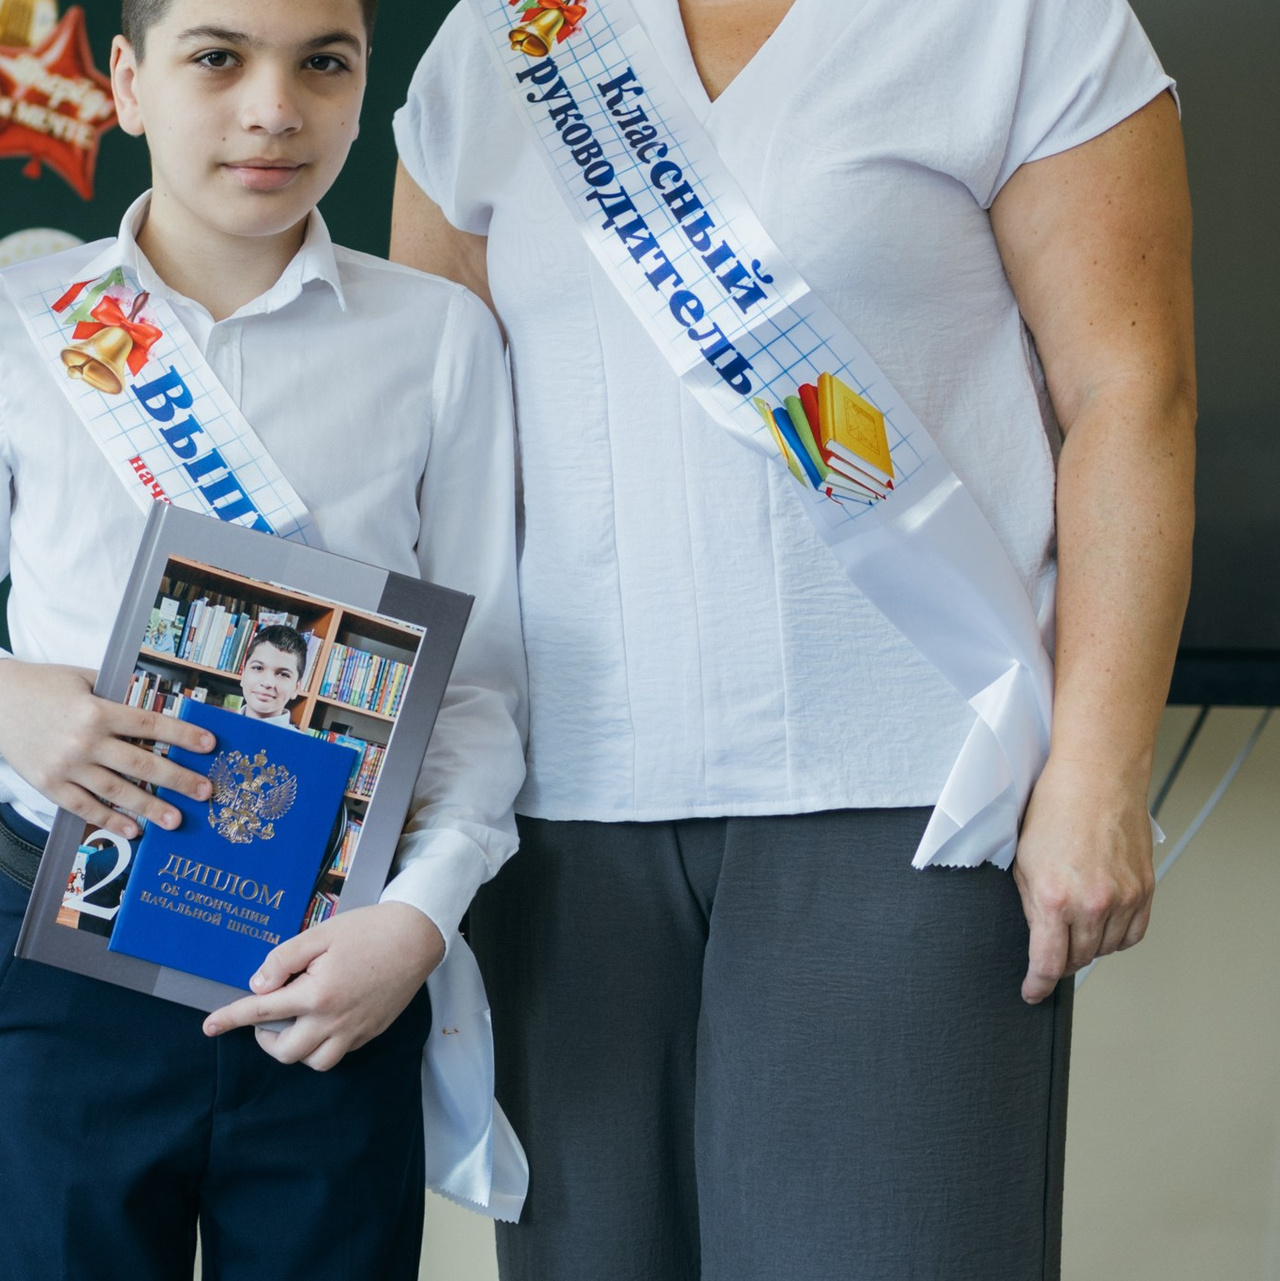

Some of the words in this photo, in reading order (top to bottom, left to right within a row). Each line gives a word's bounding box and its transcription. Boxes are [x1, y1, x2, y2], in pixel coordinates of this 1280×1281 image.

[596, 67, 774, 315] Классный
[515, 57, 754, 396] руководитель
[158, 853, 286, 910] ДИПЛОМ
[160, 882, 180, 896] ОБ
[184, 889, 270, 926] ОКОНЧАНИИ
[139, 890, 222, 926] НАЧАЛЬНОЙ
[226, 919, 281, 945] ШКОЛЫ
